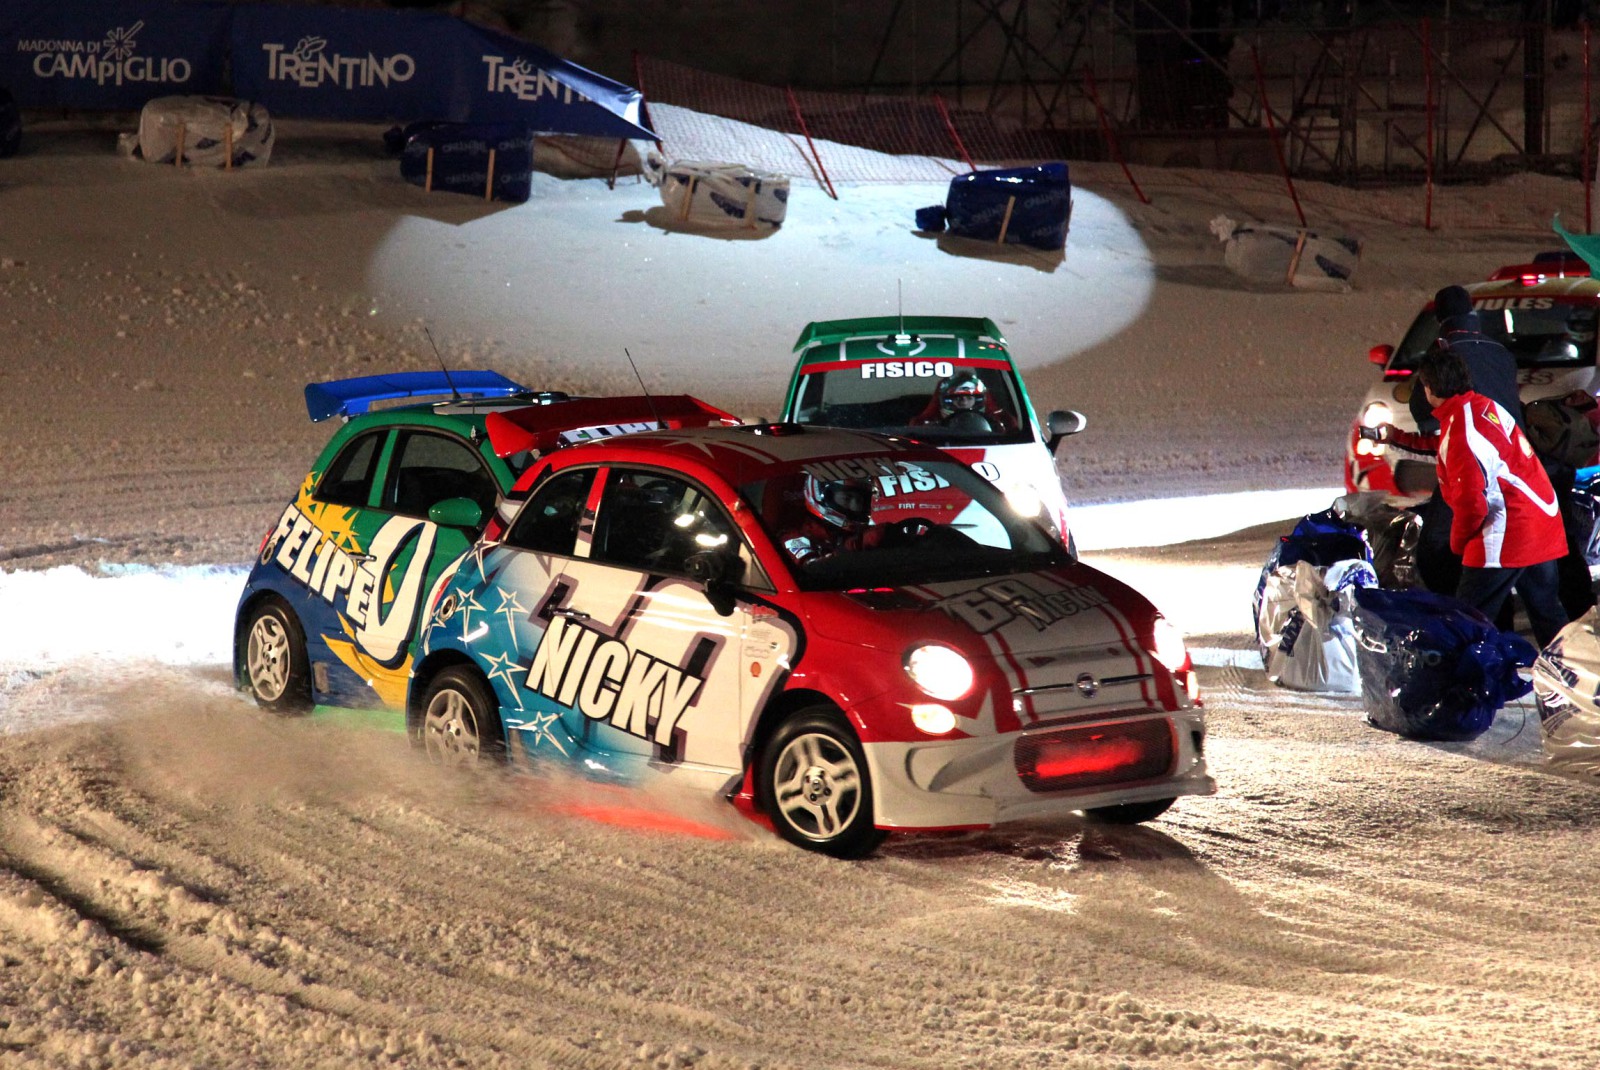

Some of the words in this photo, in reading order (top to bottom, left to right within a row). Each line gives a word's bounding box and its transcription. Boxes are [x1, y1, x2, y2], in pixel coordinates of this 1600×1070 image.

[18, 40, 84, 53] MADONNA
[87, 41, 100, 53] DI
[262, 43, 415, 89] TRENTINO
[860, 361, 954, 379] FISICO
[802, 456, 897, 482] NICKY
[274, 503, 376, 632] FELIPE
[522, 615, 703, 748] NICKY
